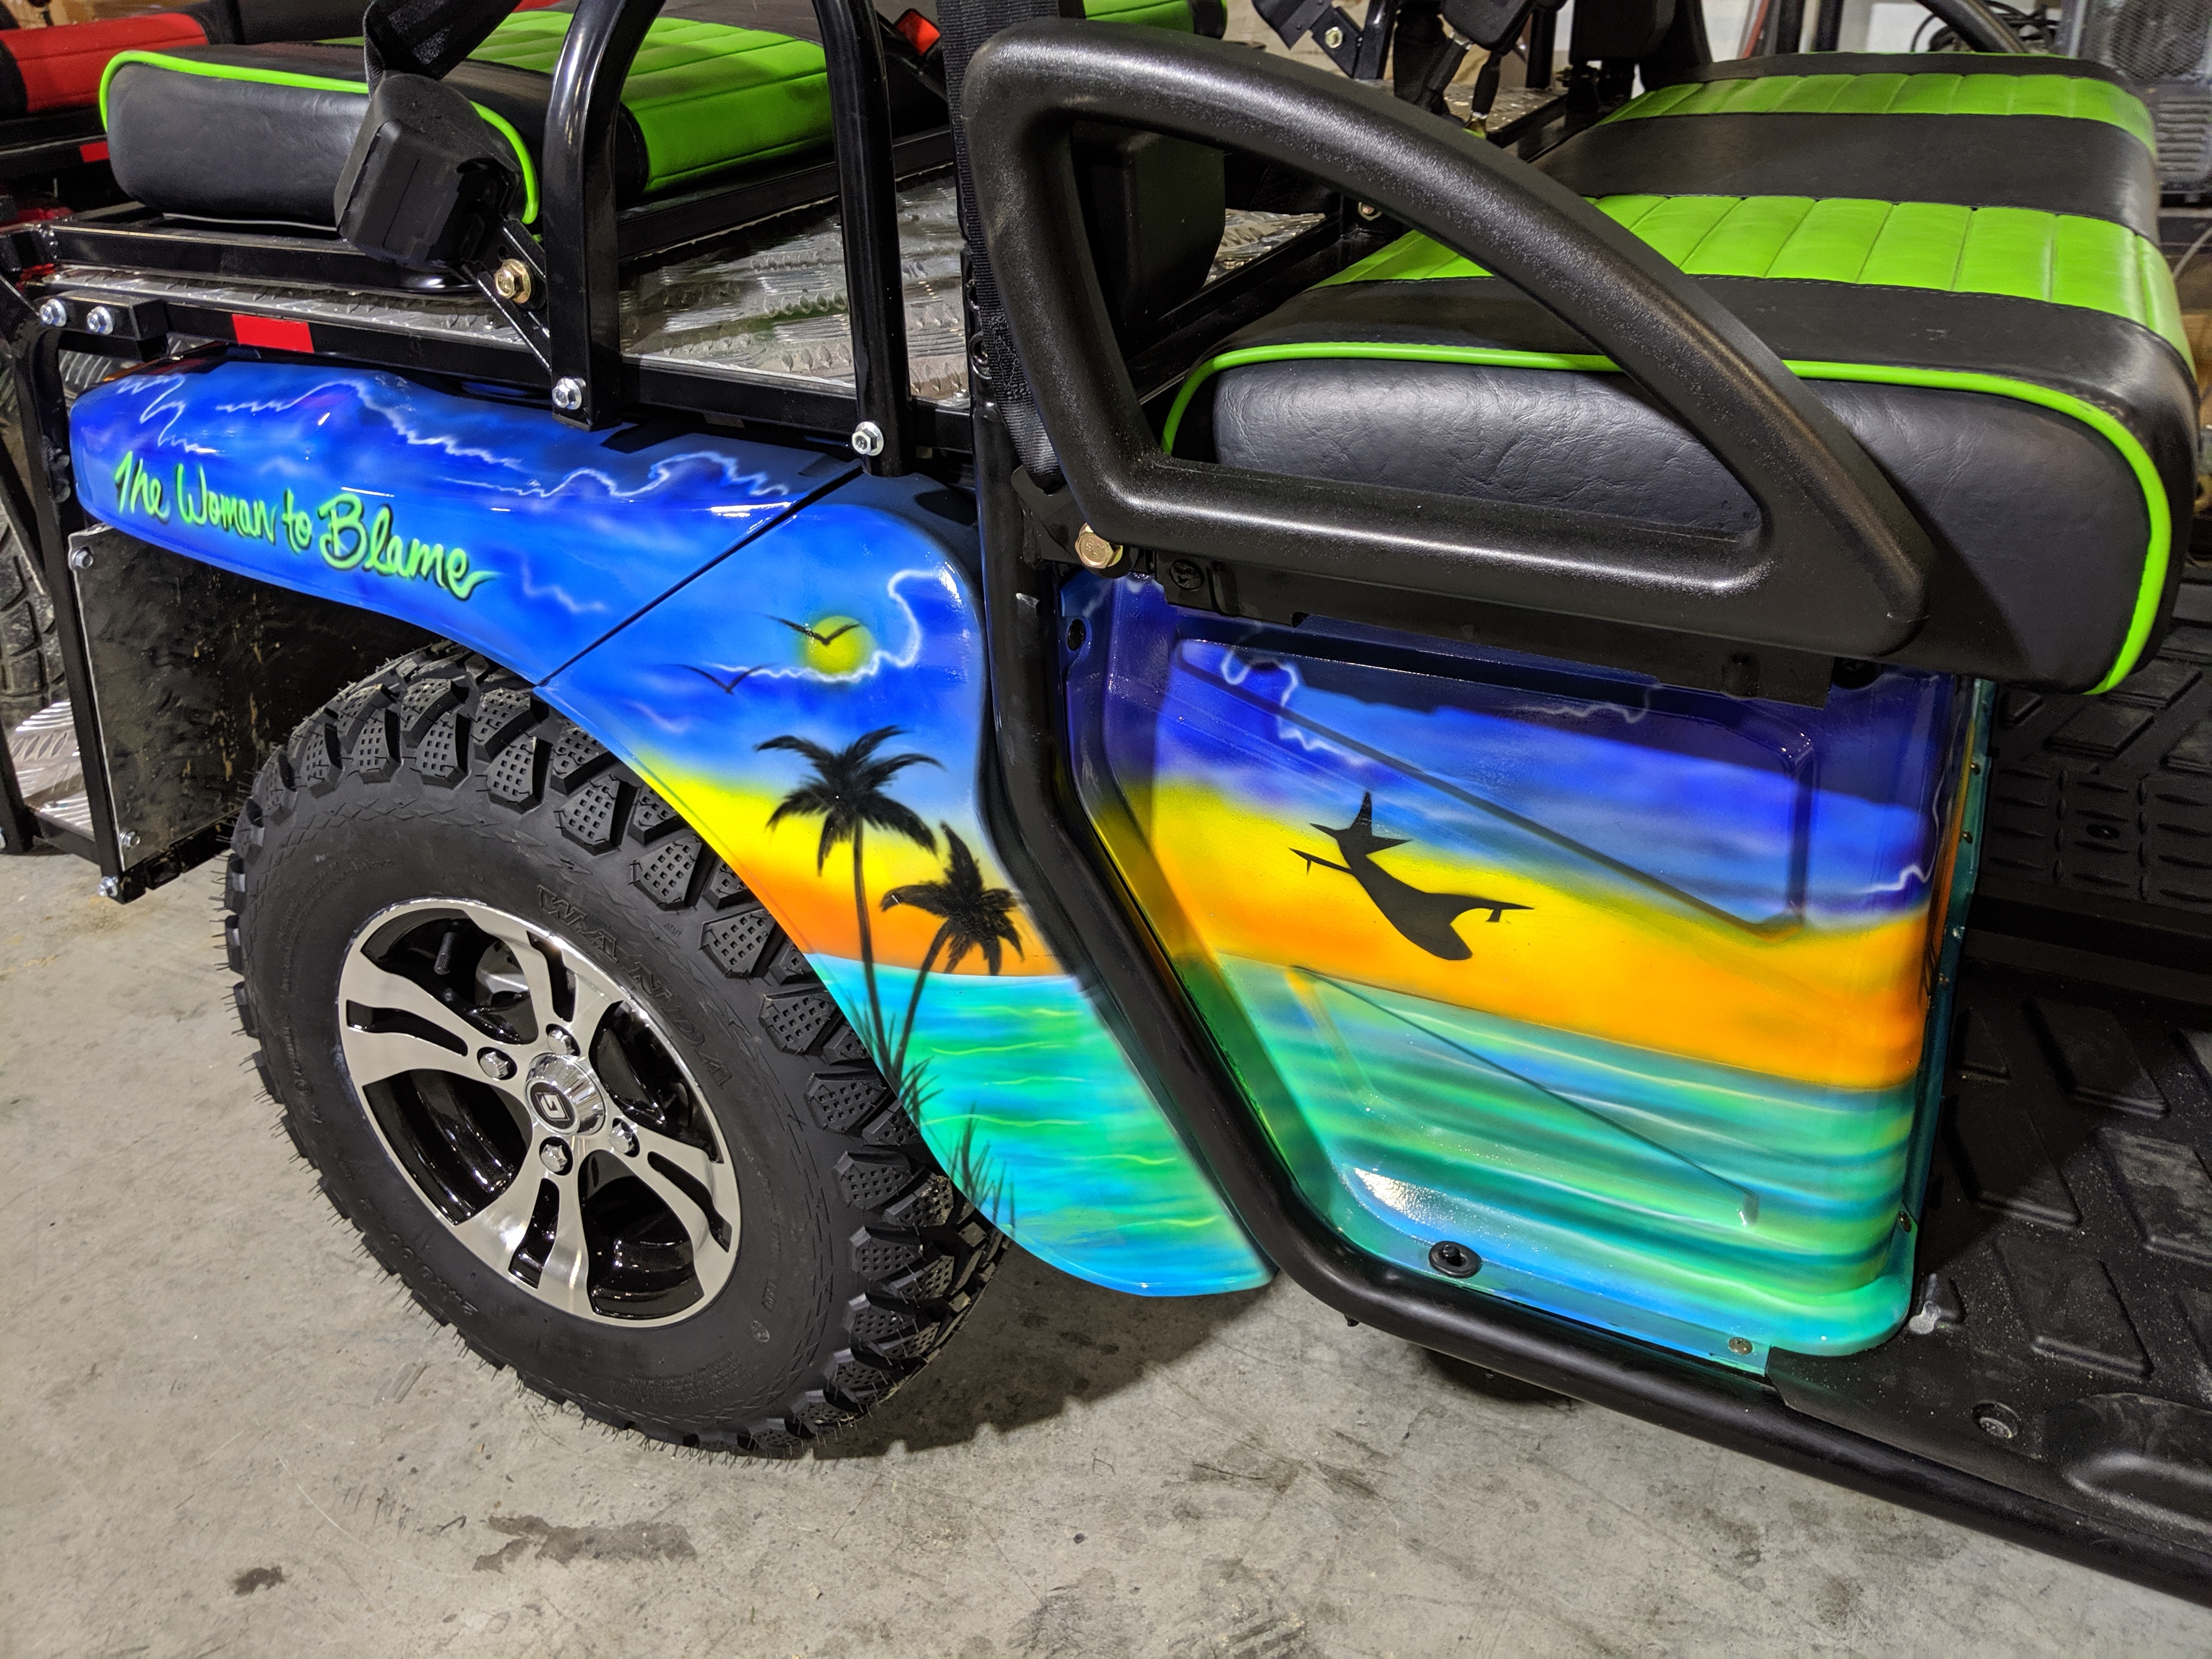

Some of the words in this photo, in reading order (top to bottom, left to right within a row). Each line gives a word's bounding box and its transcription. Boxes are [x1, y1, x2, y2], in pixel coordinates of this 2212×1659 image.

[115, 451, 167, 520] The
[175, 463, 275, 544] Woman
[283, 488, 313, 553] to
[318, 493, 498, 600] Blame
